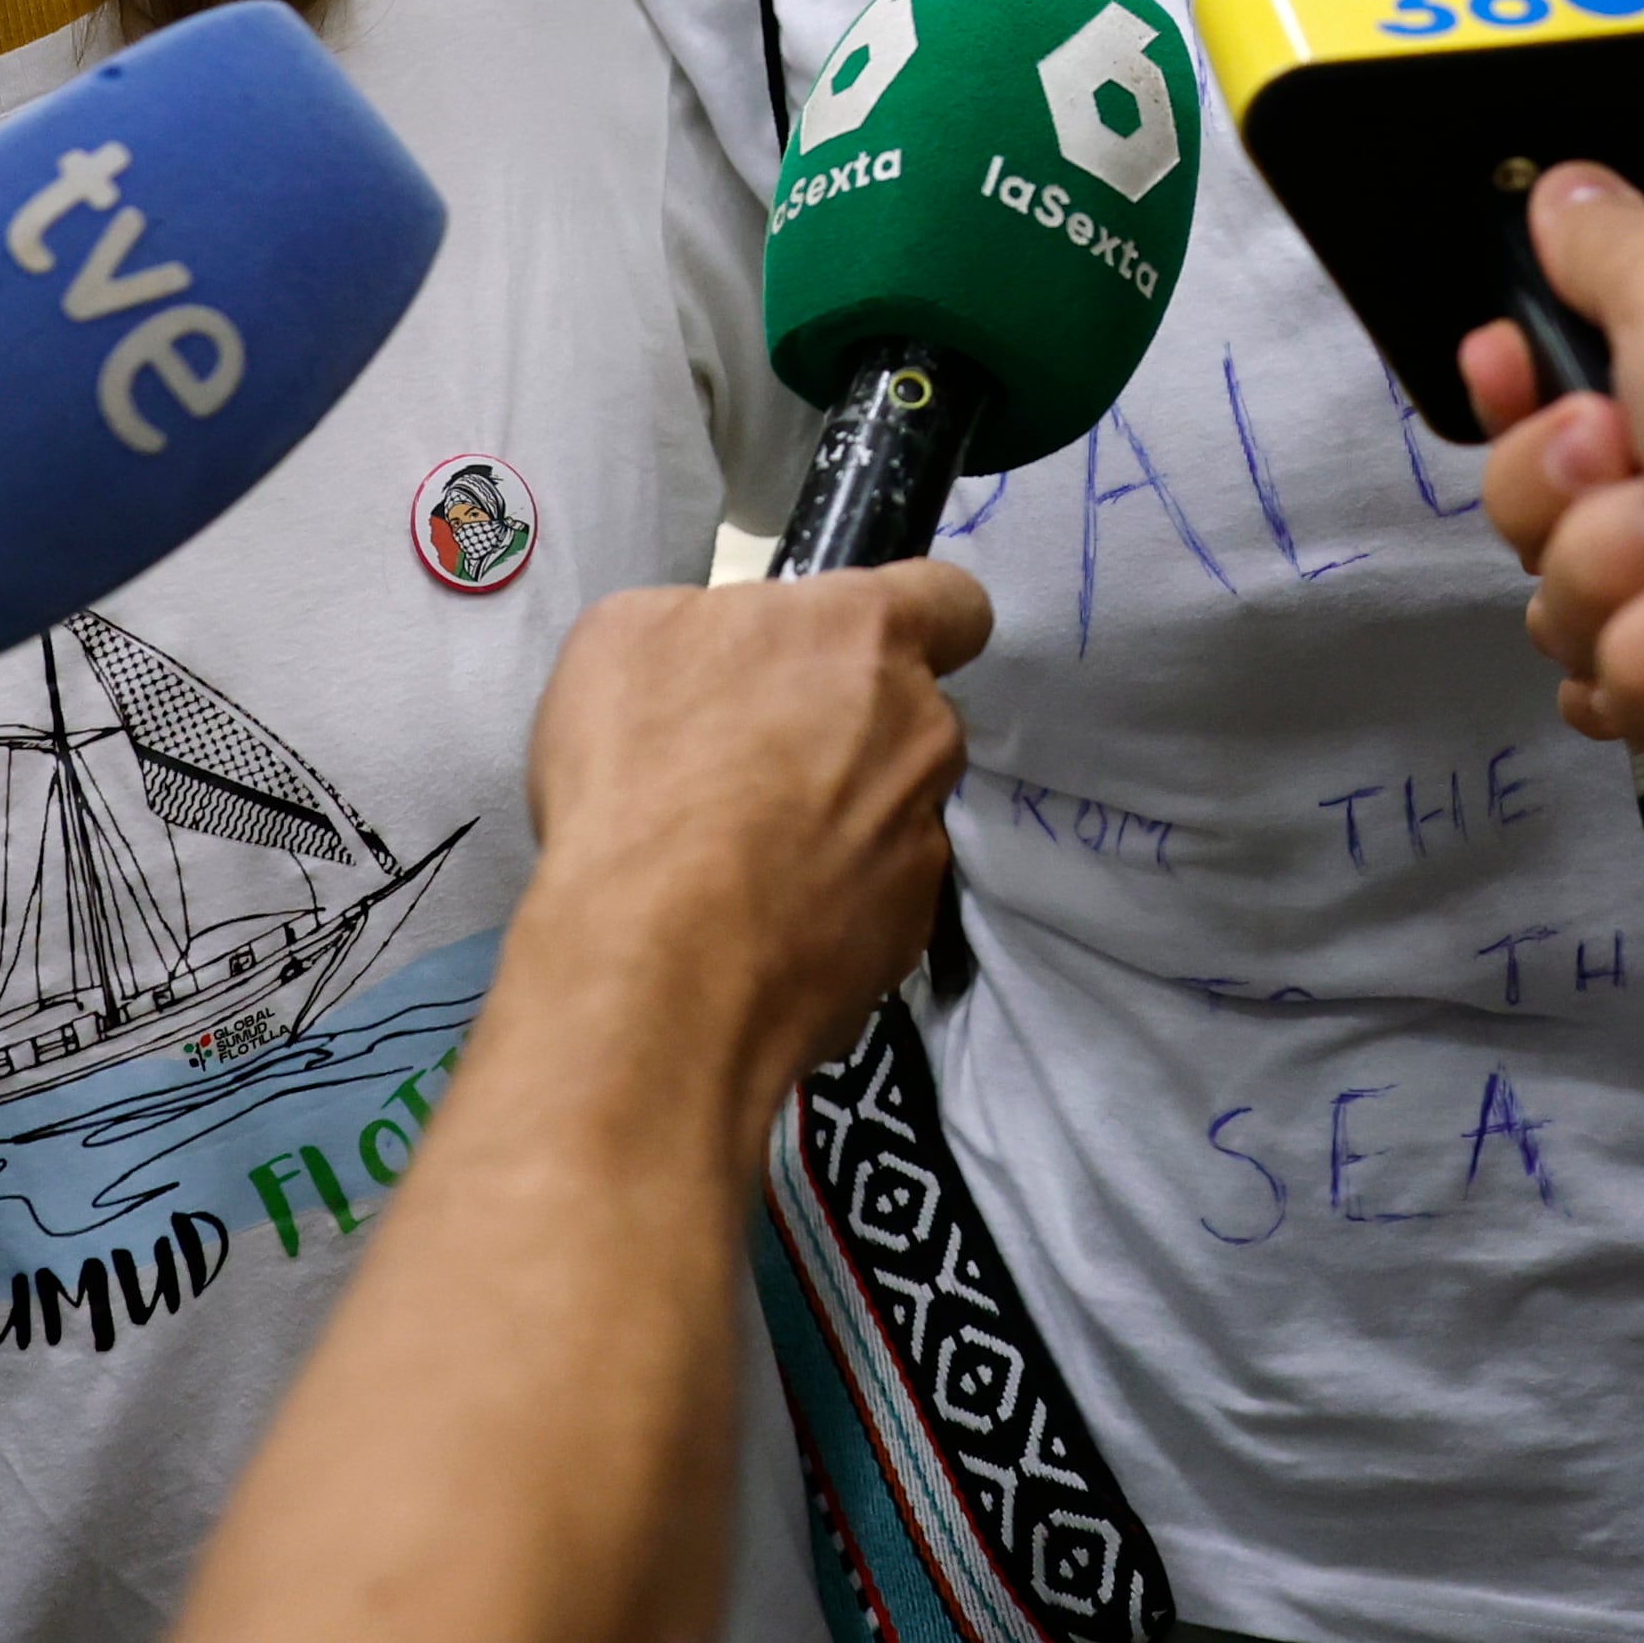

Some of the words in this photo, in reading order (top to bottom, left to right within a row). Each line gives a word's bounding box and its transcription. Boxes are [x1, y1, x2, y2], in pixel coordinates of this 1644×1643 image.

[770, 147, 903, 236] aSexta
[980, 154, 1159, 301] laSexta
[5, 139, 246, 457] tve
[954, 774, 1179, 876] ROM
[1319, 745, 1549, 868] THE
[212, 1007, 276, 1041] GLOBAL
[216, 1020, 268, 1053] SUMUD
[218, 1023, 293, 1065] FLOTILLA
[247, 1029, 465, 1259] FLOT
[1200, 1062, 1571, 1245] SEA
